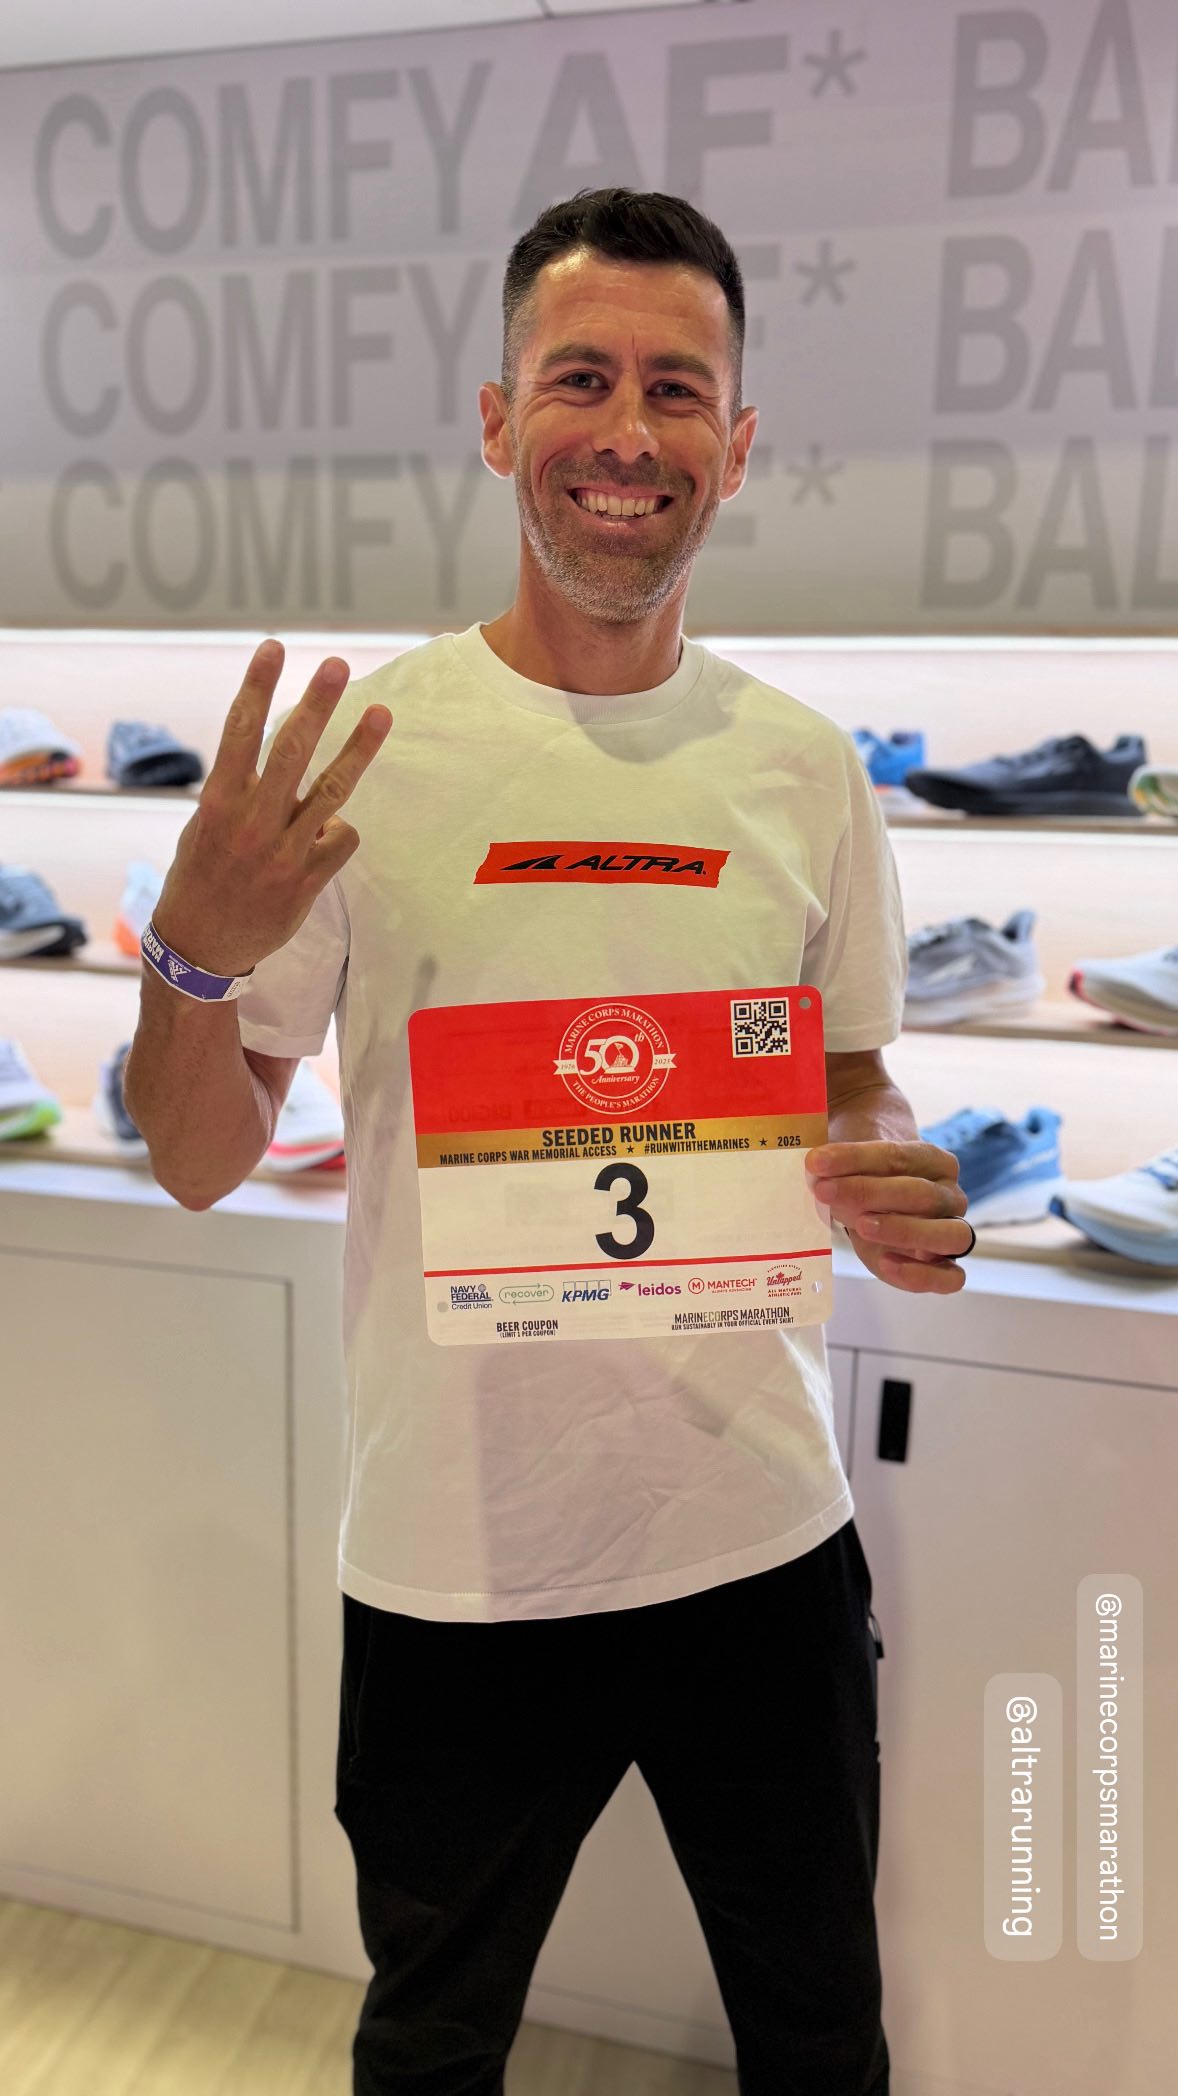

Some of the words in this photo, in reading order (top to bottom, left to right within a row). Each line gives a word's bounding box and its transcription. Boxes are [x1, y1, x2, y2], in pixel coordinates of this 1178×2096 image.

[34, 60, 492, 259] COMFY
[945, 0, 1178, 199] BA
[41, 261, 490, 439] COMFY
[48, 452, 486, 614] COMFY
[565, 1017, 589, 1053] MARINE
[588, 1008, 620, 1022] CORPS
[621, 1009, 664, 1049] MARATHON
[591, 1075, 640, 1084] Anniversary
[572, 1081, 587, 1096] THE
[585, 1093, 622, 1108] PEOPLE'S
[622, 1077, 660, 1107] MARATHON
[542, 1127, 614, 1147] SEEDED
[620, 1122, 696, 1143] RUNNER
[440, 1153, 475, 1165] MARINE
[477, 1151, 507, 1163] CORPS
[509, 1150, 529, 1161] WAR
[532, 1148, 580, 1160] MEMORIAL
[582, 1145, 617, 1157] ACCESS
[644, 1138, 750, 1154] #RUNWITHTHEMARINES
[777, 1135, 801, 1147] 2025
[593, 1162, 655, 1260] 3
[707, 1279, 755, 1289] MANTECH
[767, 1271, 802, 1286] Untapped
[450, 1285, 476, 1293] NAVY
[451, 1291, 491, 1300] FEDERAL
[504, 1289, 549, 1299] recover
[562, 1288, 610, 1302] KPMG
[638, 1282, 682, 1296] leidos
[740, 1307, 790, 1320] MARATHON
[496, 1321, 520, 1332] BEER
[522, 1319, 559, 1330] COUPON
[683, 1322, 716, 1330] SUSTAINABLY
[738, 1319, 761, 1327] OFFICIAL
[762, 1318, 779, 1326] EVENT
